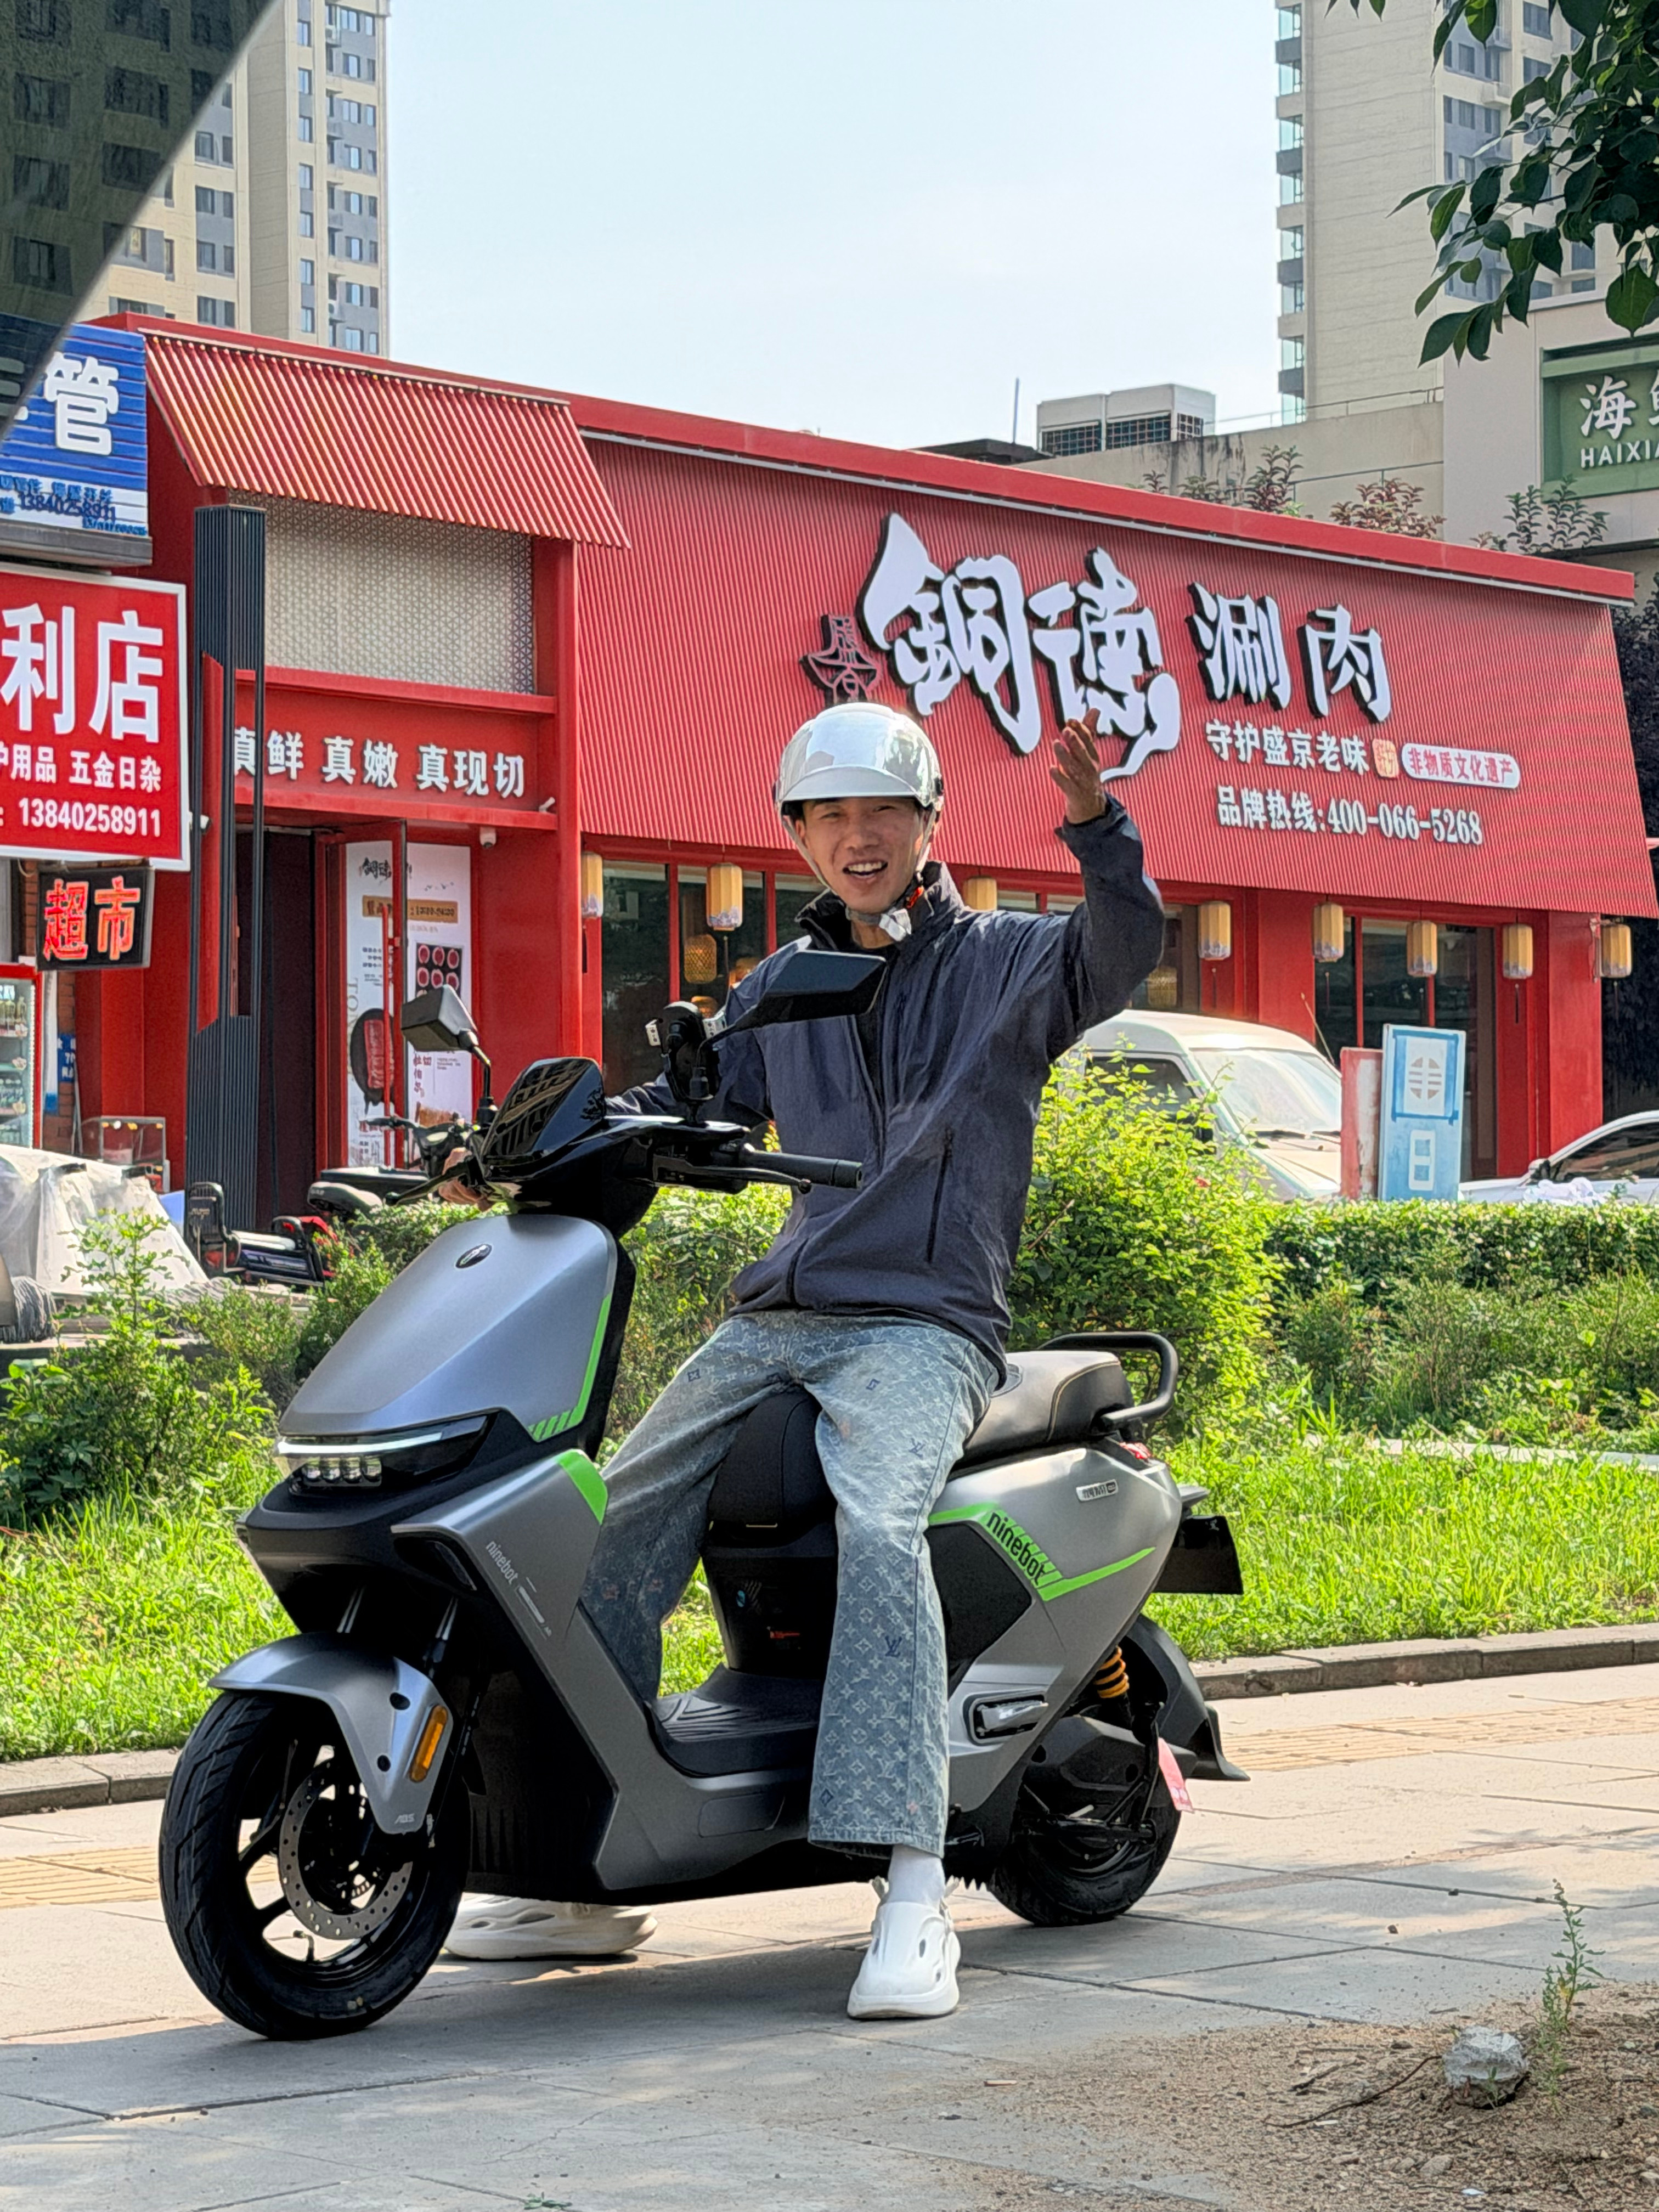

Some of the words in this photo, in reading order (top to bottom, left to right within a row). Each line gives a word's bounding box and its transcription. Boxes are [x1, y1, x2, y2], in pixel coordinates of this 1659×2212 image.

[1579, 369, 1659, 439] 海
[1581, 439, 1659, 468] HAIXI
[1193, 582, 1392, 723] 涮肉
[69, 751, 161, 793] 五金日杂
[234, 726, 303, 780] 真鲜
[322, 735, 399, 788] 真嫩
[416, 743, 524, 798] 真现切
[1206, 718, 1370, 776] 守护盛京老味
[1407, 747, 1514, 783] 非物质文化遗产
[18, 797, 160, 837] 13840258911
[43, 875, 141, 961] 超市
[486, 1541, 518, 1585] ninebot
[987, 1512, 1045, 1586] ninebot
